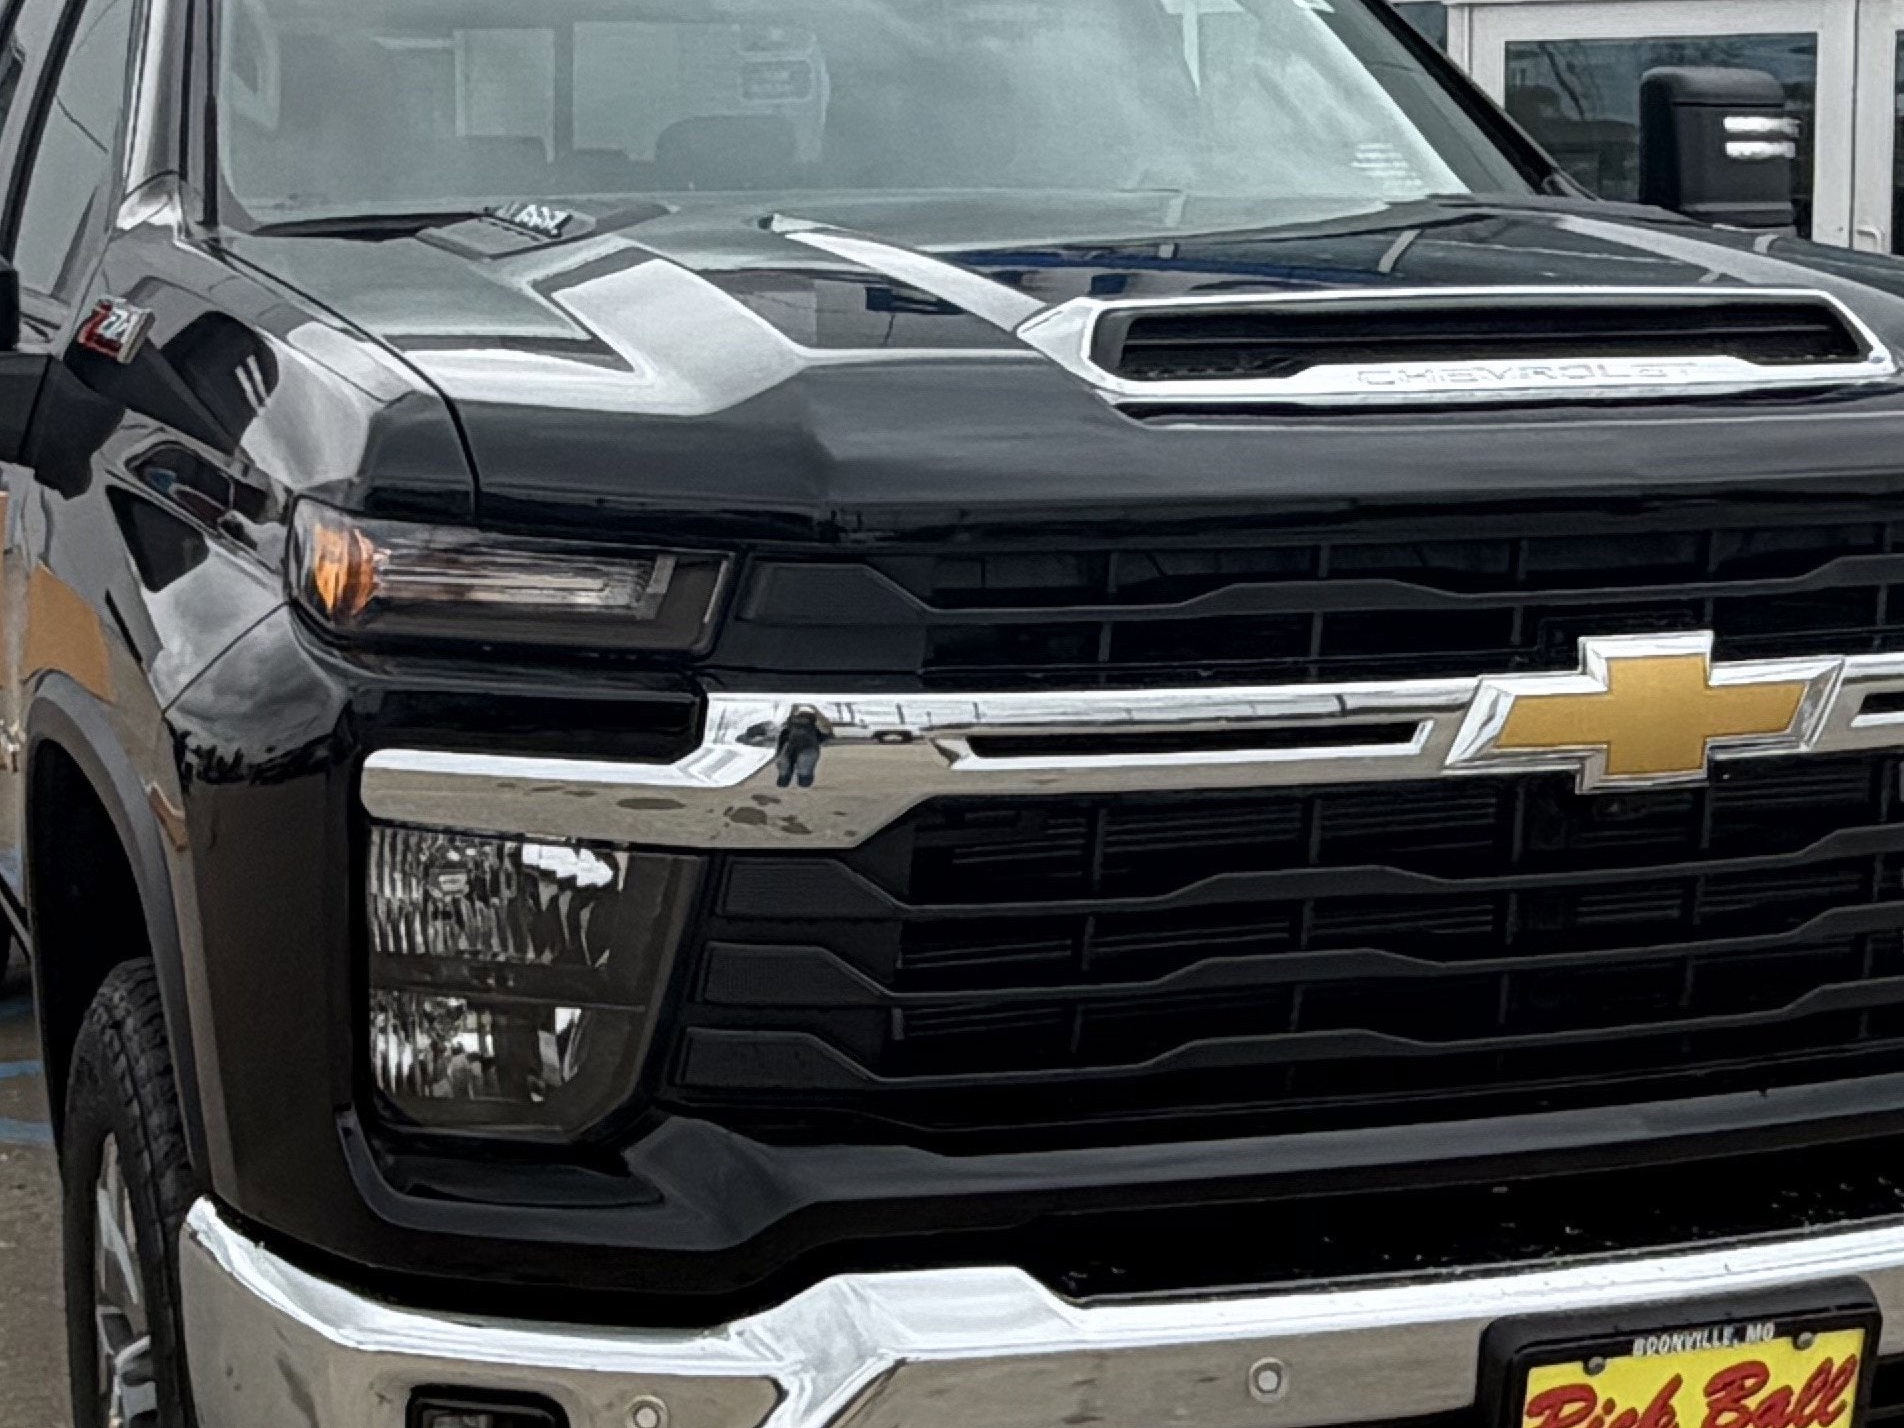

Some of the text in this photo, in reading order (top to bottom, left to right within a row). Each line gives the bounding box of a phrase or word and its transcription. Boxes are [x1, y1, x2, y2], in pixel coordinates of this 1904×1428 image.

[1357, 361, 1698, 386] CHEVROLET
[1632, 1321, 1775, 1358] BOONVILLE, MO
